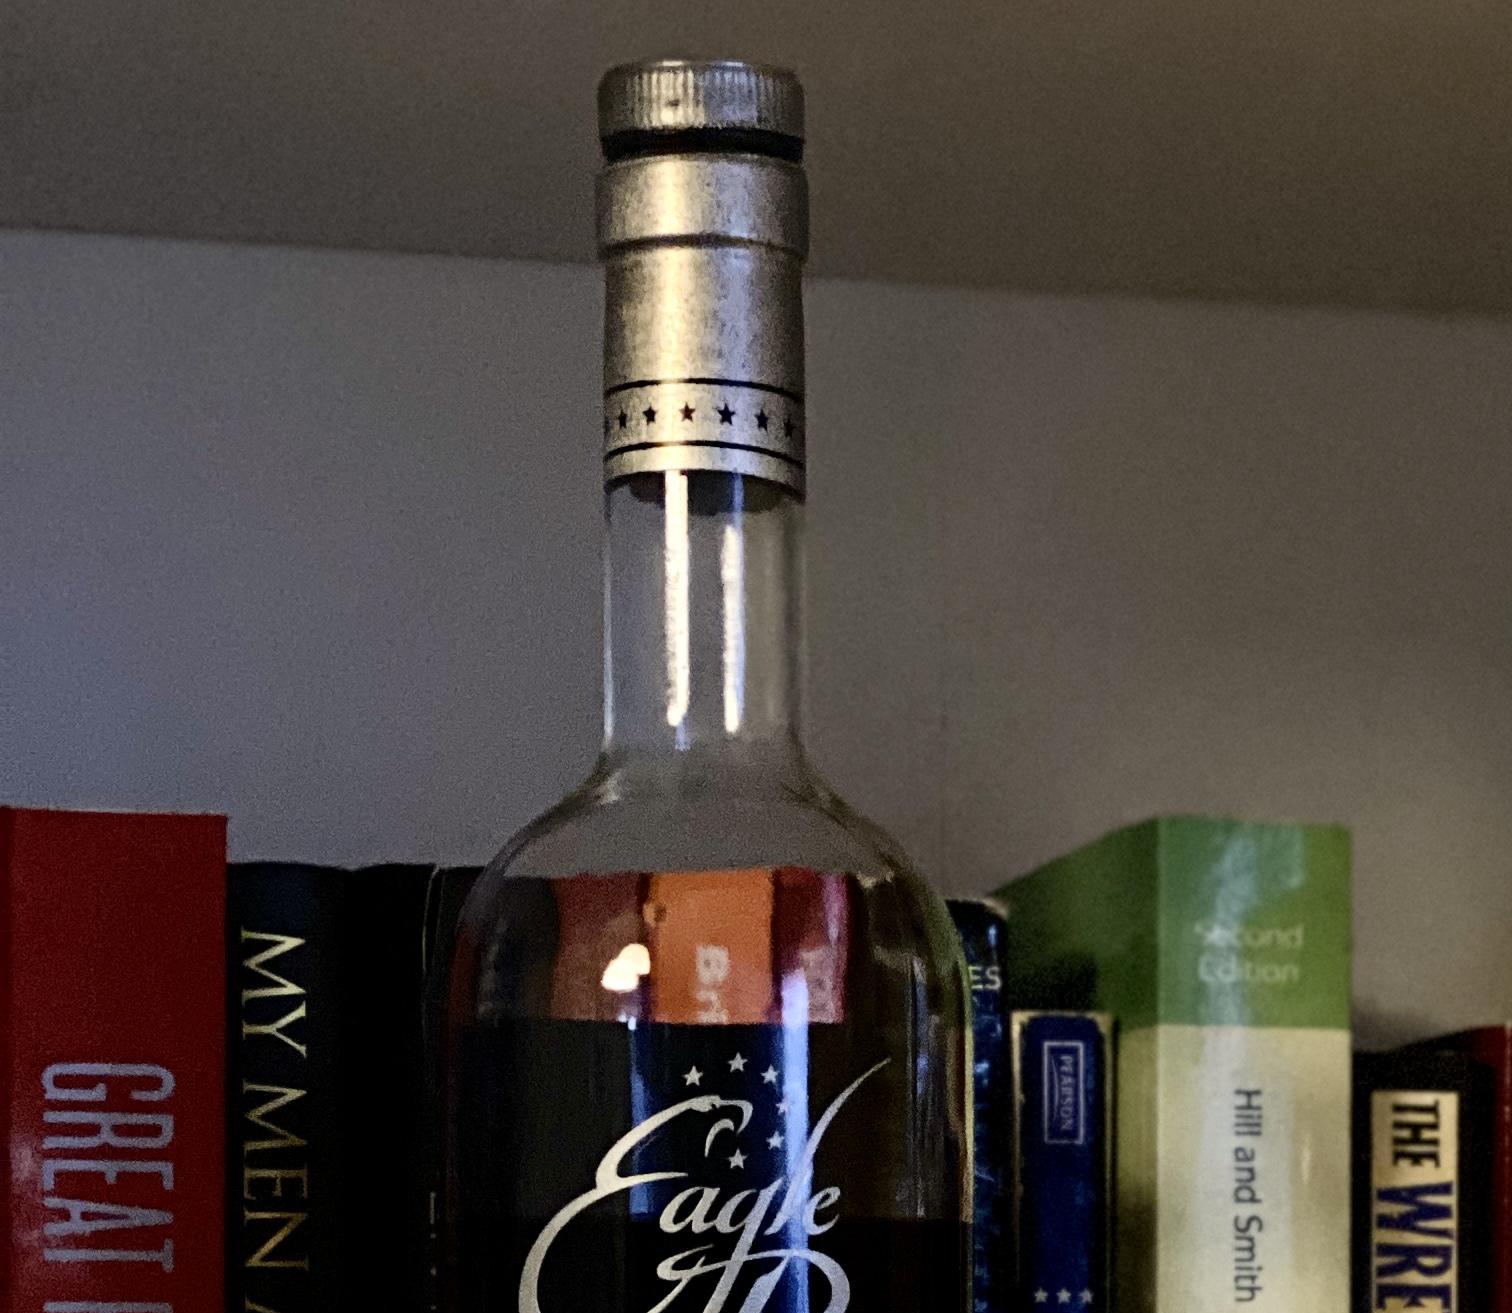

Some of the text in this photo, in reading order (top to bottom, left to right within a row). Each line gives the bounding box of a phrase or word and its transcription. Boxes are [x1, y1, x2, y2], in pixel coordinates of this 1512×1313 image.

[240, 926, 308, 1058] MY
[1199, 954, 1300, 982] Edition
[1058, 1054, 1075, 1131] PEARSON
[1392, 1100, 1441, 1168] THE
[41, 1061, 175, 1274] GREAT
[242, 1081, 310, 1271] MEN
[1233, 1087, 1264, 1303] Hill and Smith
